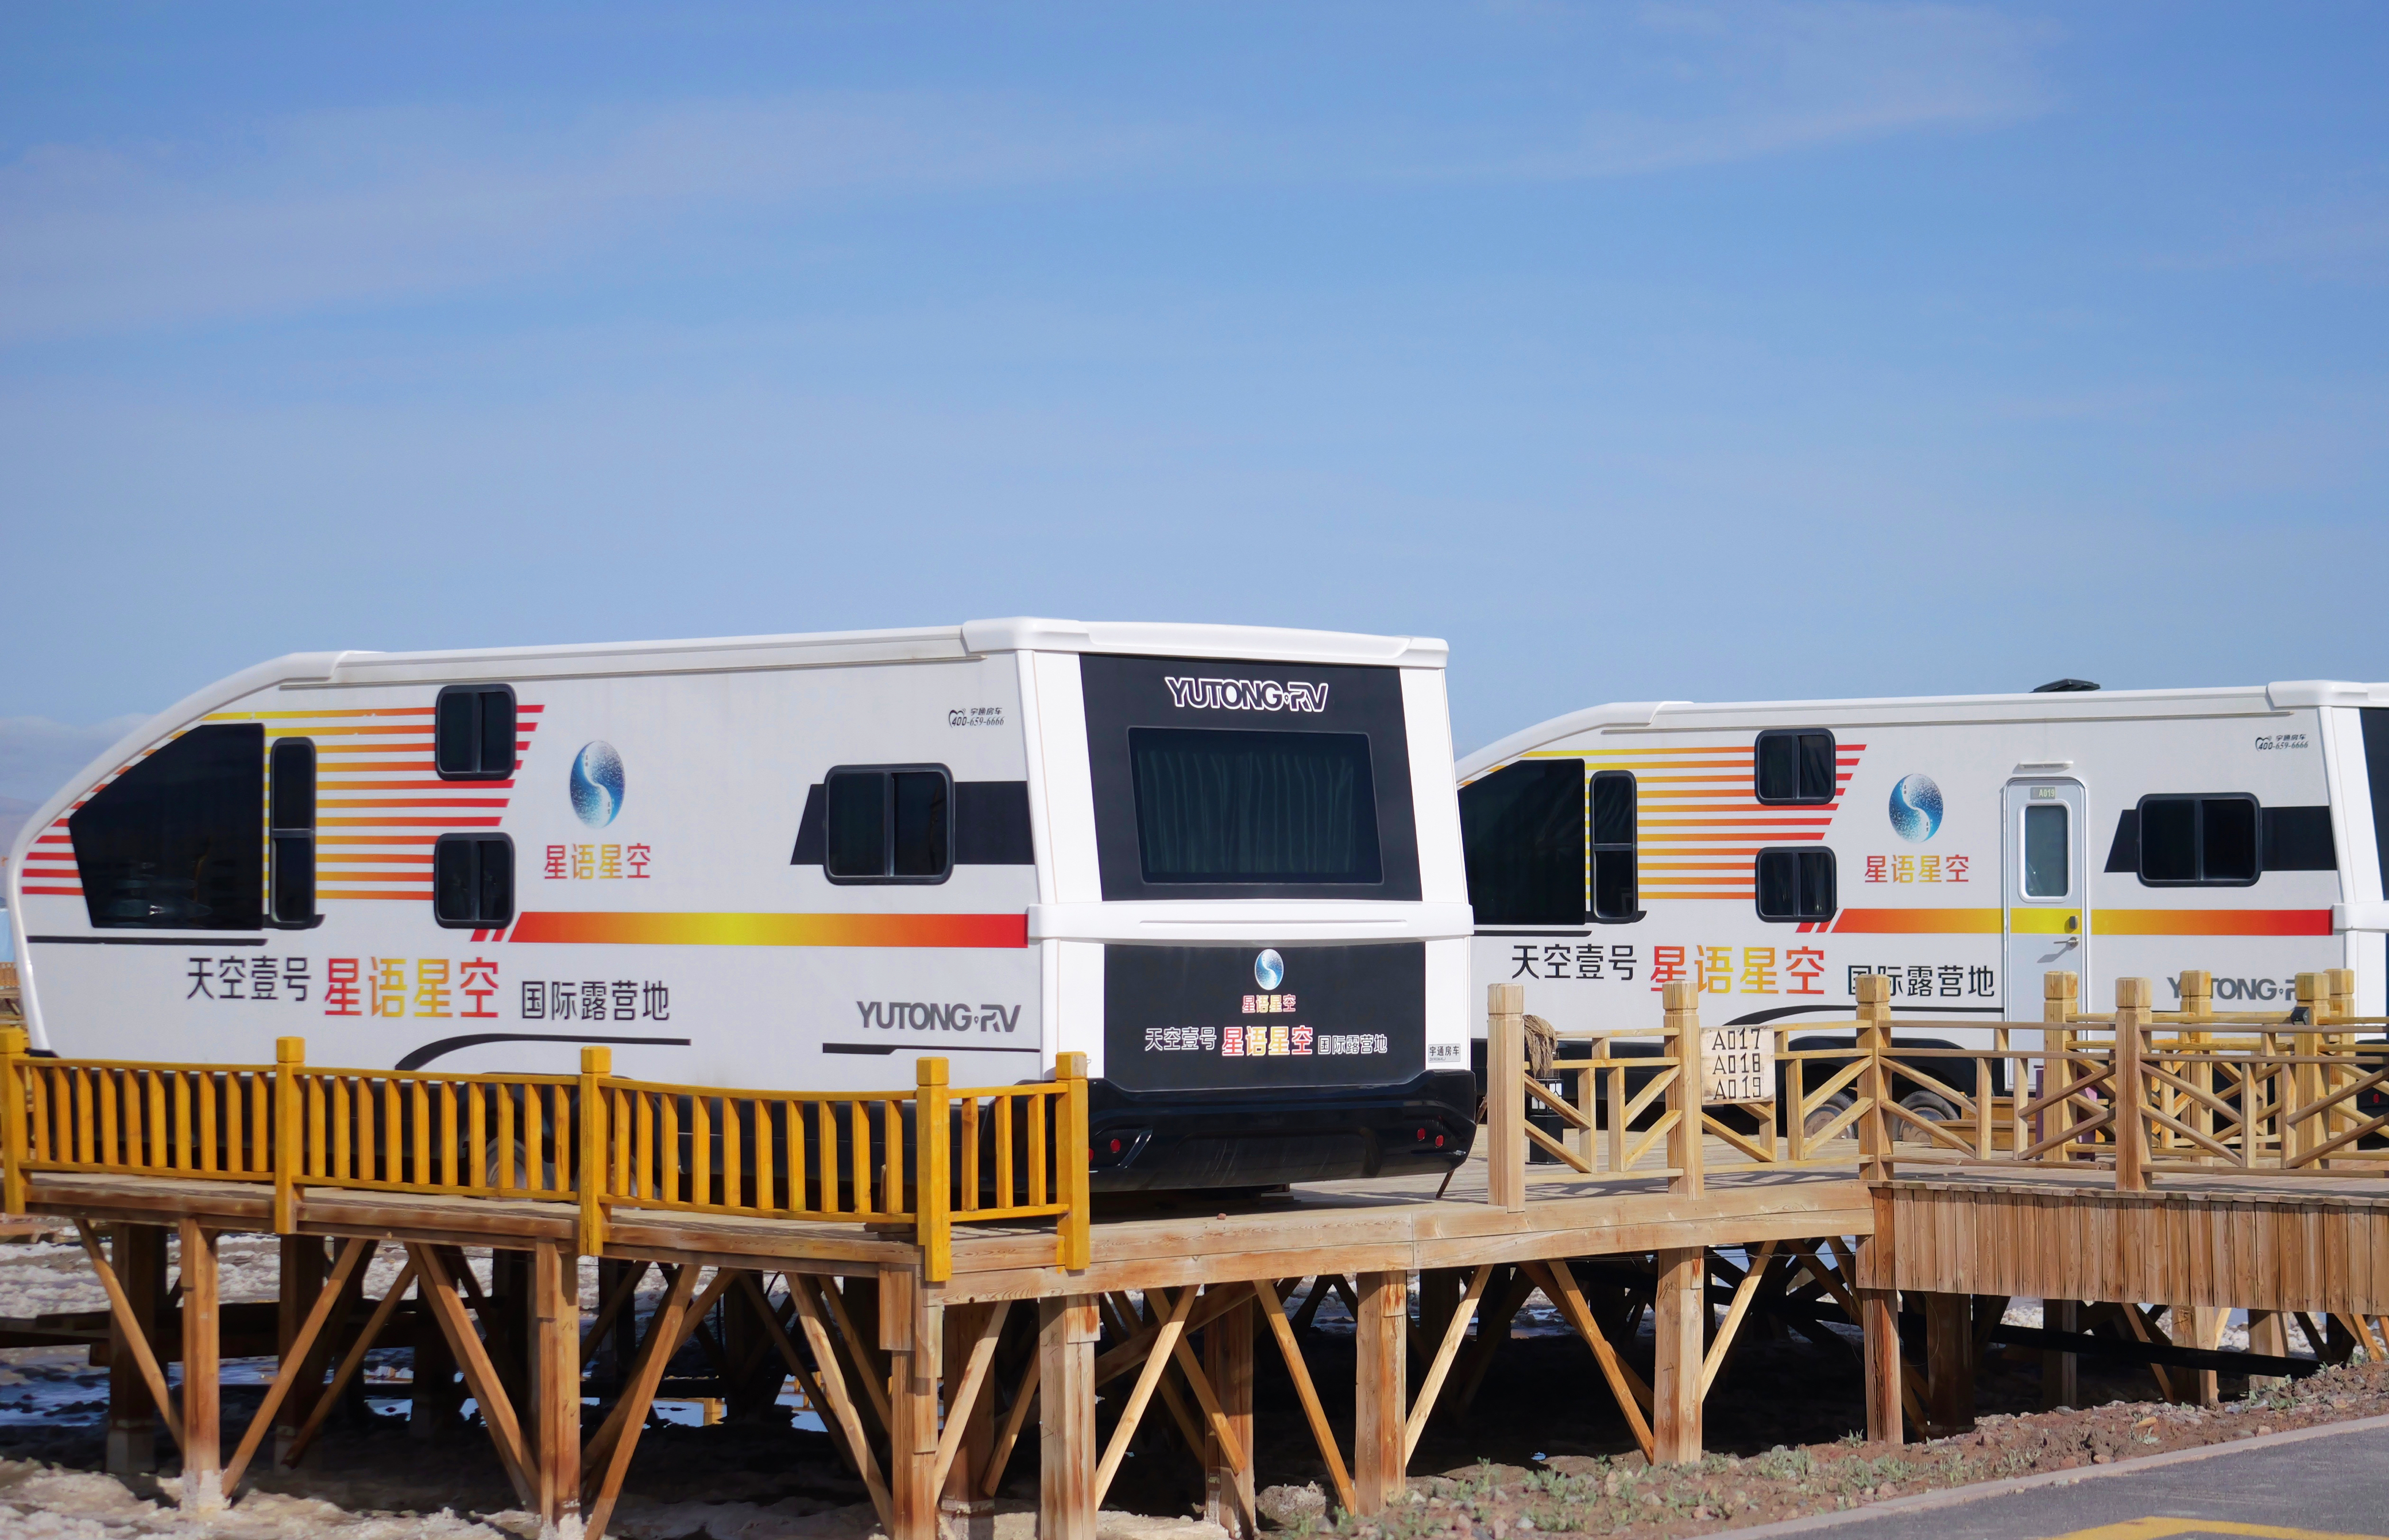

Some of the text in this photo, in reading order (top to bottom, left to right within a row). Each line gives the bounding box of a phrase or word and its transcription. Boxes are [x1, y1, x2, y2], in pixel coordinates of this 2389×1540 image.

[952, 716, 1005, 726] 400-659-6666
[971, 707, 1003, 716] 宇通房车
[2258, 741, 2309, 750] 400-659-6666
[2039, 789, 2055, 797] A019
[544, 843, 651, 880] 星语星空
[1865, 854, 1969, 883] 星语星空
[1512, 943, 1637, 980] 天空壹号
[1650, 945, 1824, 995] 星语星空
[187, 956, 670, 1020] 天空壹号 星语星空 国际露营地
[2167, 977, 2276, 1001] YTONG
[1242, 994, 1296, 1013] 星语星空
[1145, 1025, 1387, 1057] 天空壹号 星语星空 国际露营地
[1712, 1027, 1760, 1050] A017
[1429, 1046, 1459, 1057] 宇通房车
[1712, 1052, 1760, 1074] A018
[1713, 1075, 1761, 1100] A019
